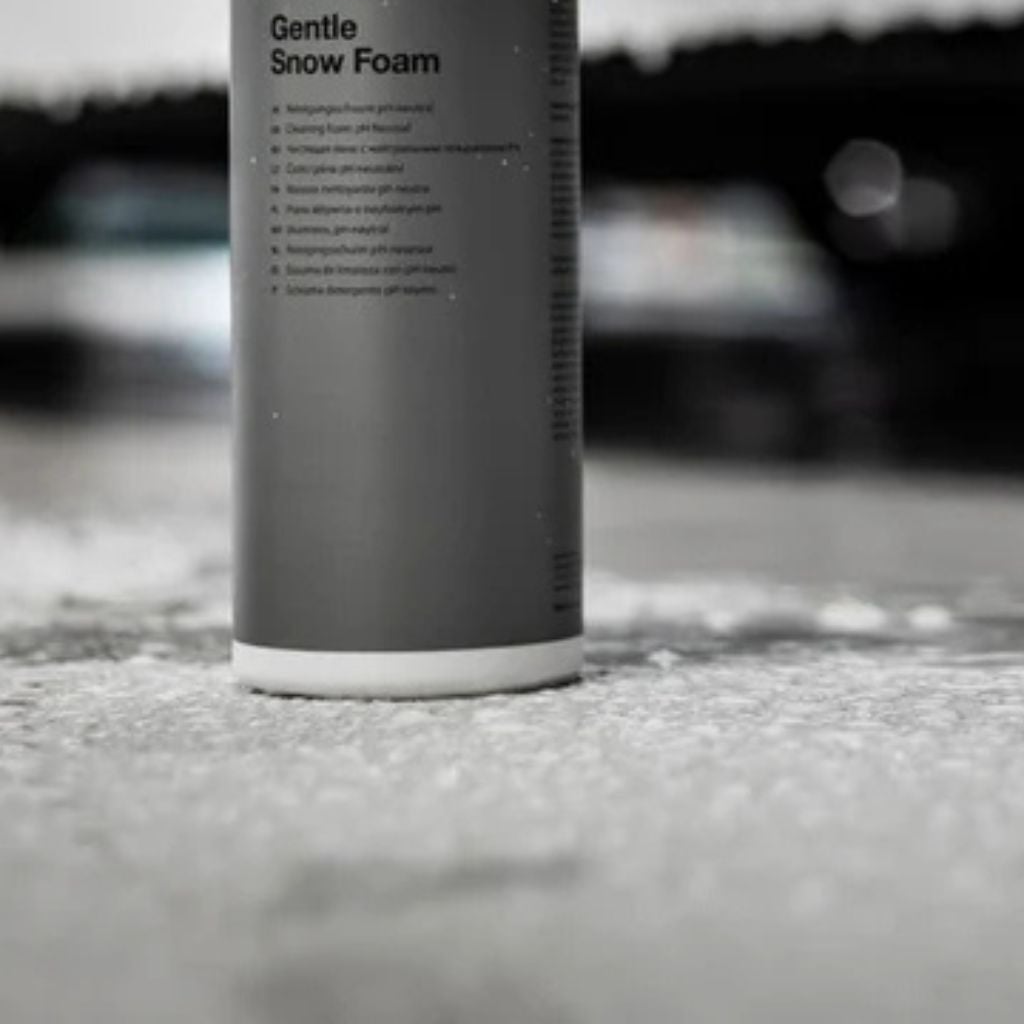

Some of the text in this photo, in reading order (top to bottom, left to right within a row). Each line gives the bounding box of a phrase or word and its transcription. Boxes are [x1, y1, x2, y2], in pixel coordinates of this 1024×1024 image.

[271, 13, 358, 41] Gentle
[271, 47, 440, 75] Snow Foam
